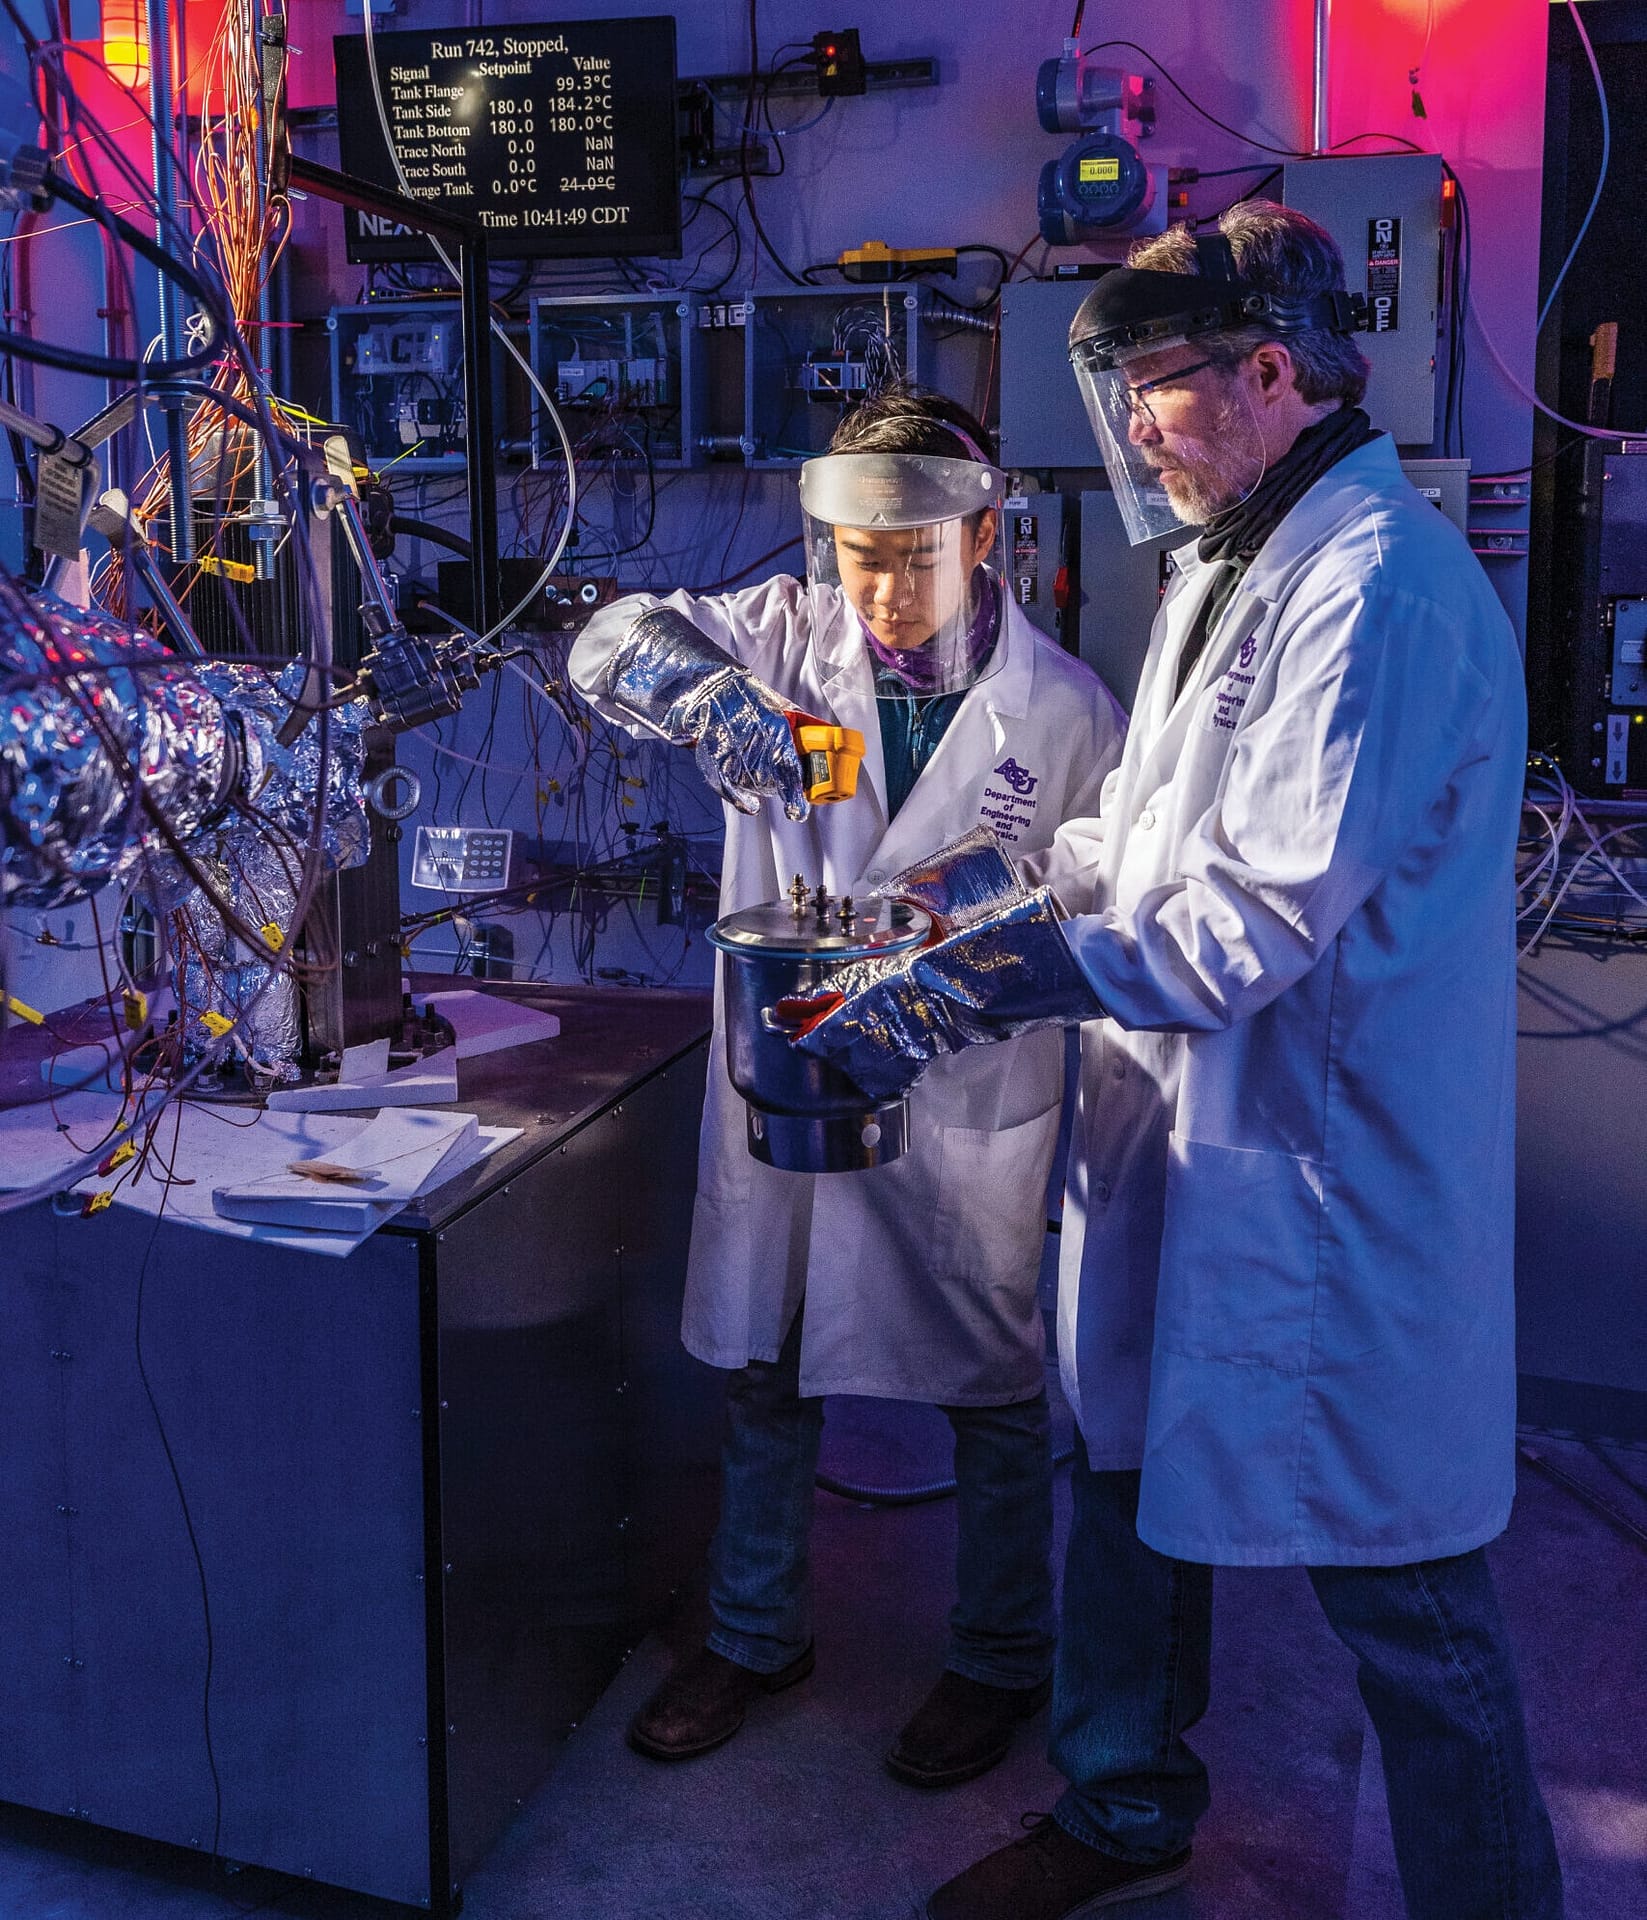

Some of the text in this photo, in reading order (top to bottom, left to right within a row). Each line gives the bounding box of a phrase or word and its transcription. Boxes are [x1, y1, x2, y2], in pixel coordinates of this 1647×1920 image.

[431, 35, 569, 59] Run 742, Stopped,
[390, 56, 611, 83] Signal Setpoint Value
[391, 75, 612, 100] Tank Flange 99.3°C
[392, 95, 612, 120] Tank Side 180.0 184.2°C
[393, 115, 613, 139] Tank Bottom 180.0 180.0°C
[395, 136, 613, 158] Trace North 0.0 NaN
[432, 162, 466, 177] South
[509, 159, 535, 174] 0.0
[586, 156, 614, 171] NaN
[398, 184, 441, 200] Sorage
[443, 181, 474, 196] Tank
[492, 179, 537, 194] 0.0°C
[479, 207, 630, 227] Time 10:41:49 CDT
[1375, 219, 1393, 243] ON
[1374, 296, 1392, 332] OFF
[1020, 517, 1032, 535] ON
[1020, 577, 1032, 604] OFF
[984, 788, 1036, 808] Department
[1003, 804, 1014, 812] of
[980, 806, 1031, 828] Engineering
[995, 821, 1012, 830] and
[995, 830, 1018, 842] ysics
